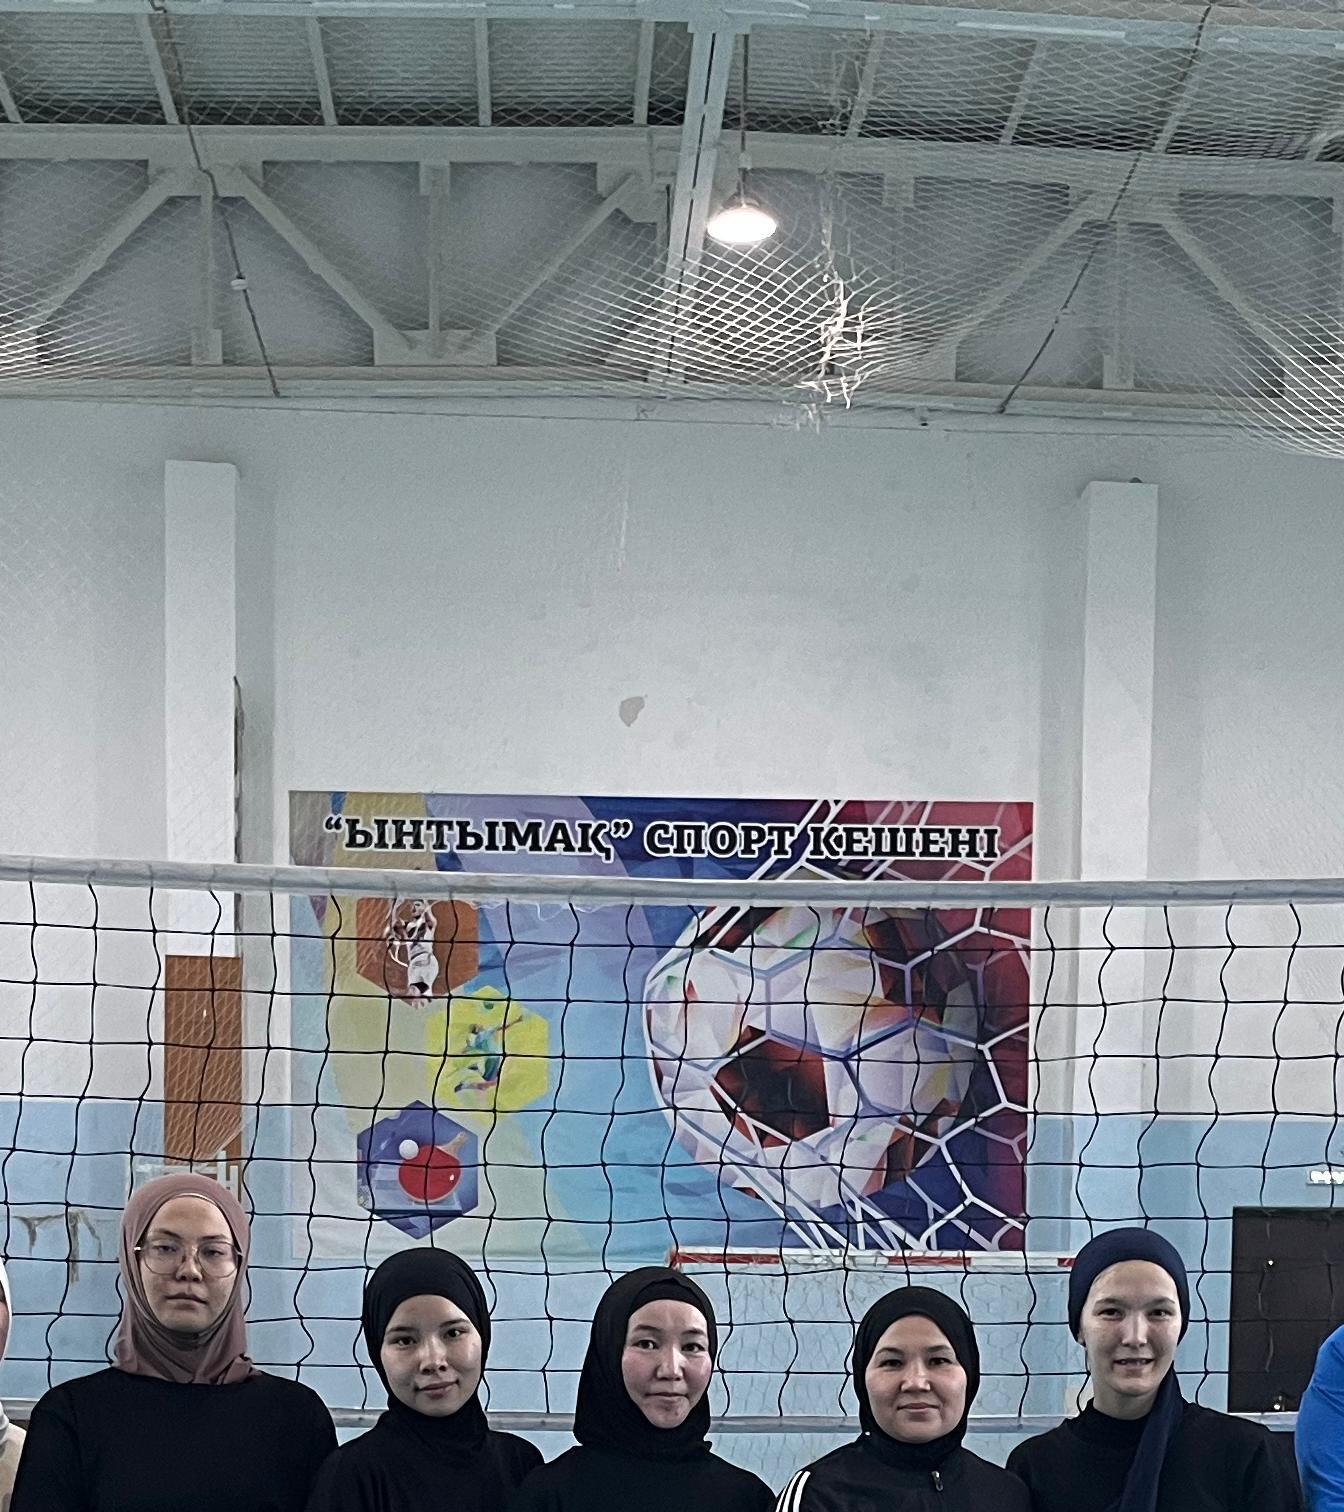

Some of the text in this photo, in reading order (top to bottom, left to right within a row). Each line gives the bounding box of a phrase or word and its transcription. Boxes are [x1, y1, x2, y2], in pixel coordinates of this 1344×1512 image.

[324, 816, 1001, 862] “ЫНТЫМАҚ” СПОРТ КЕШЕНІ
